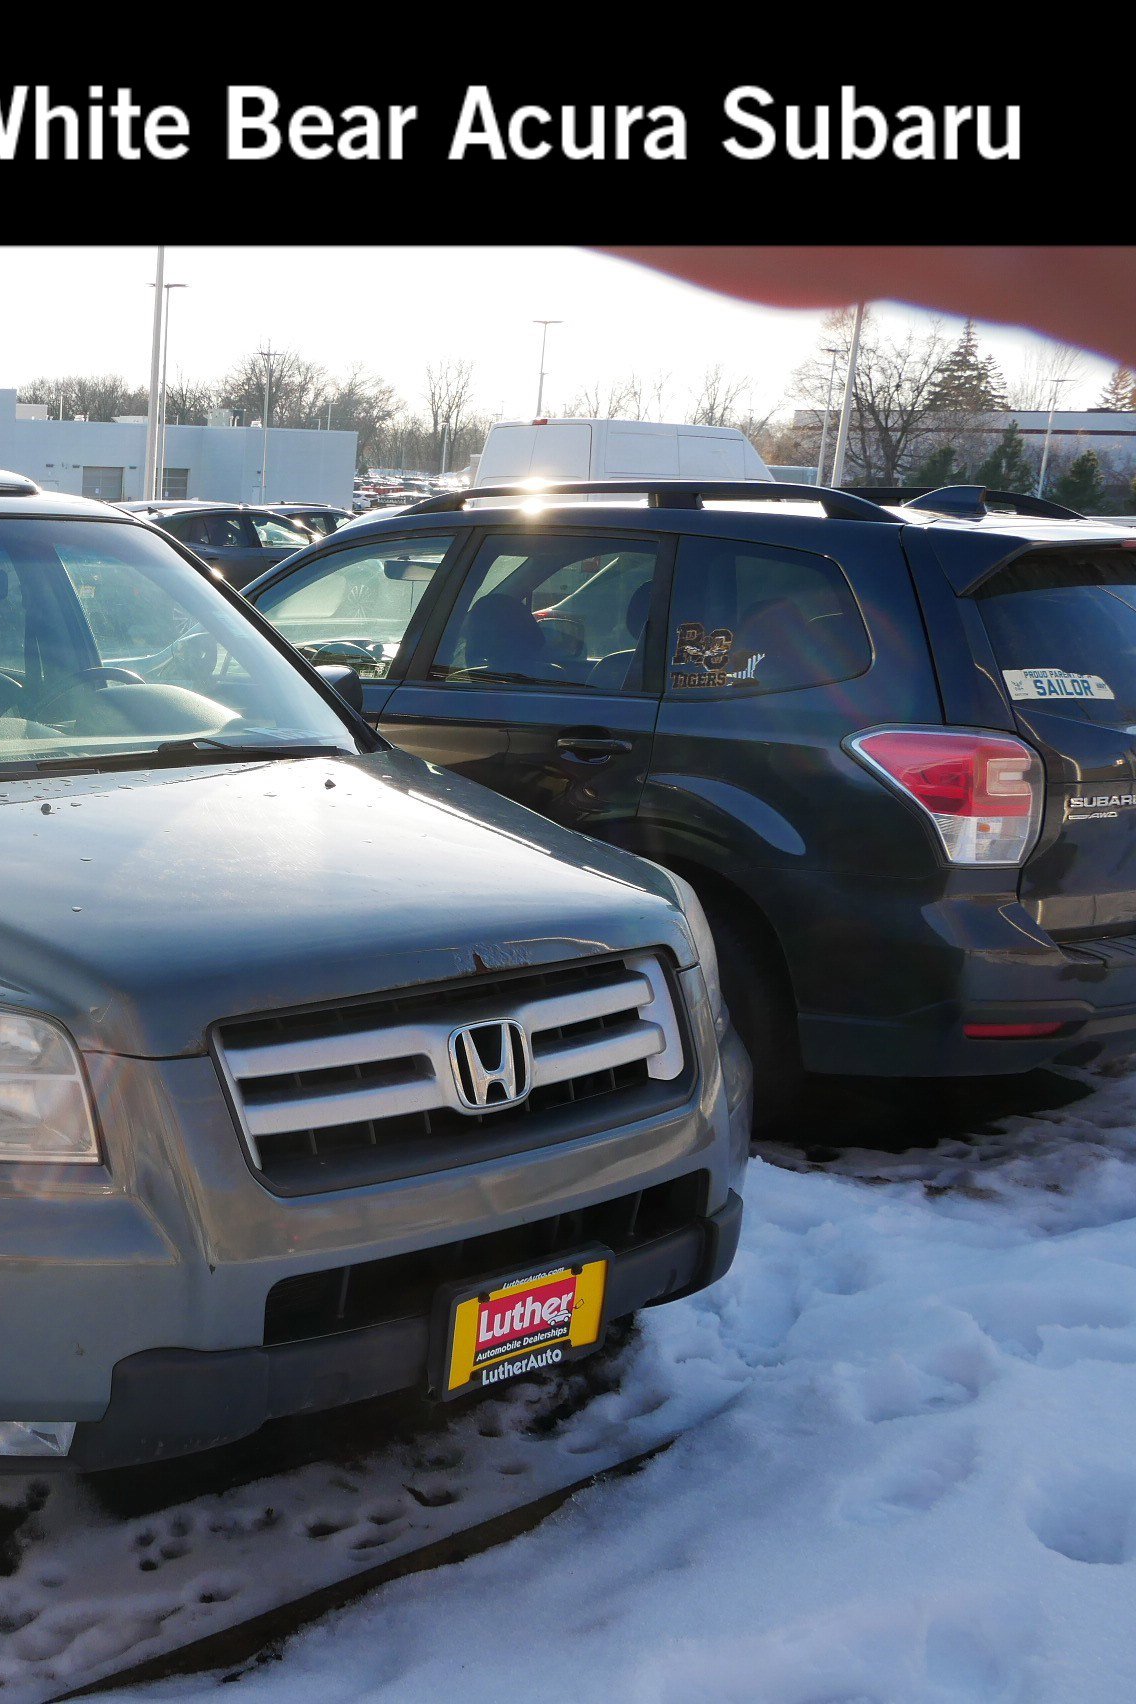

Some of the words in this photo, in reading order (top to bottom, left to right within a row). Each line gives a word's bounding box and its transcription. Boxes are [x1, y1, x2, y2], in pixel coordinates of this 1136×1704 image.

[670, 671, 727, 689] TIGERS
[1023, 670, 1048, 679] PROUD
[1032, 679, 1095, 697] SAILOR
[1070, 795, 1136, 808] SUBAR
[478, 1291, 574, 1343] Luther
[476, 1341, 522, 1362] Automobile
[522, 1326, 568, 1346] Dealerships
[482, 1348, 563, 1386] LutherAuto
